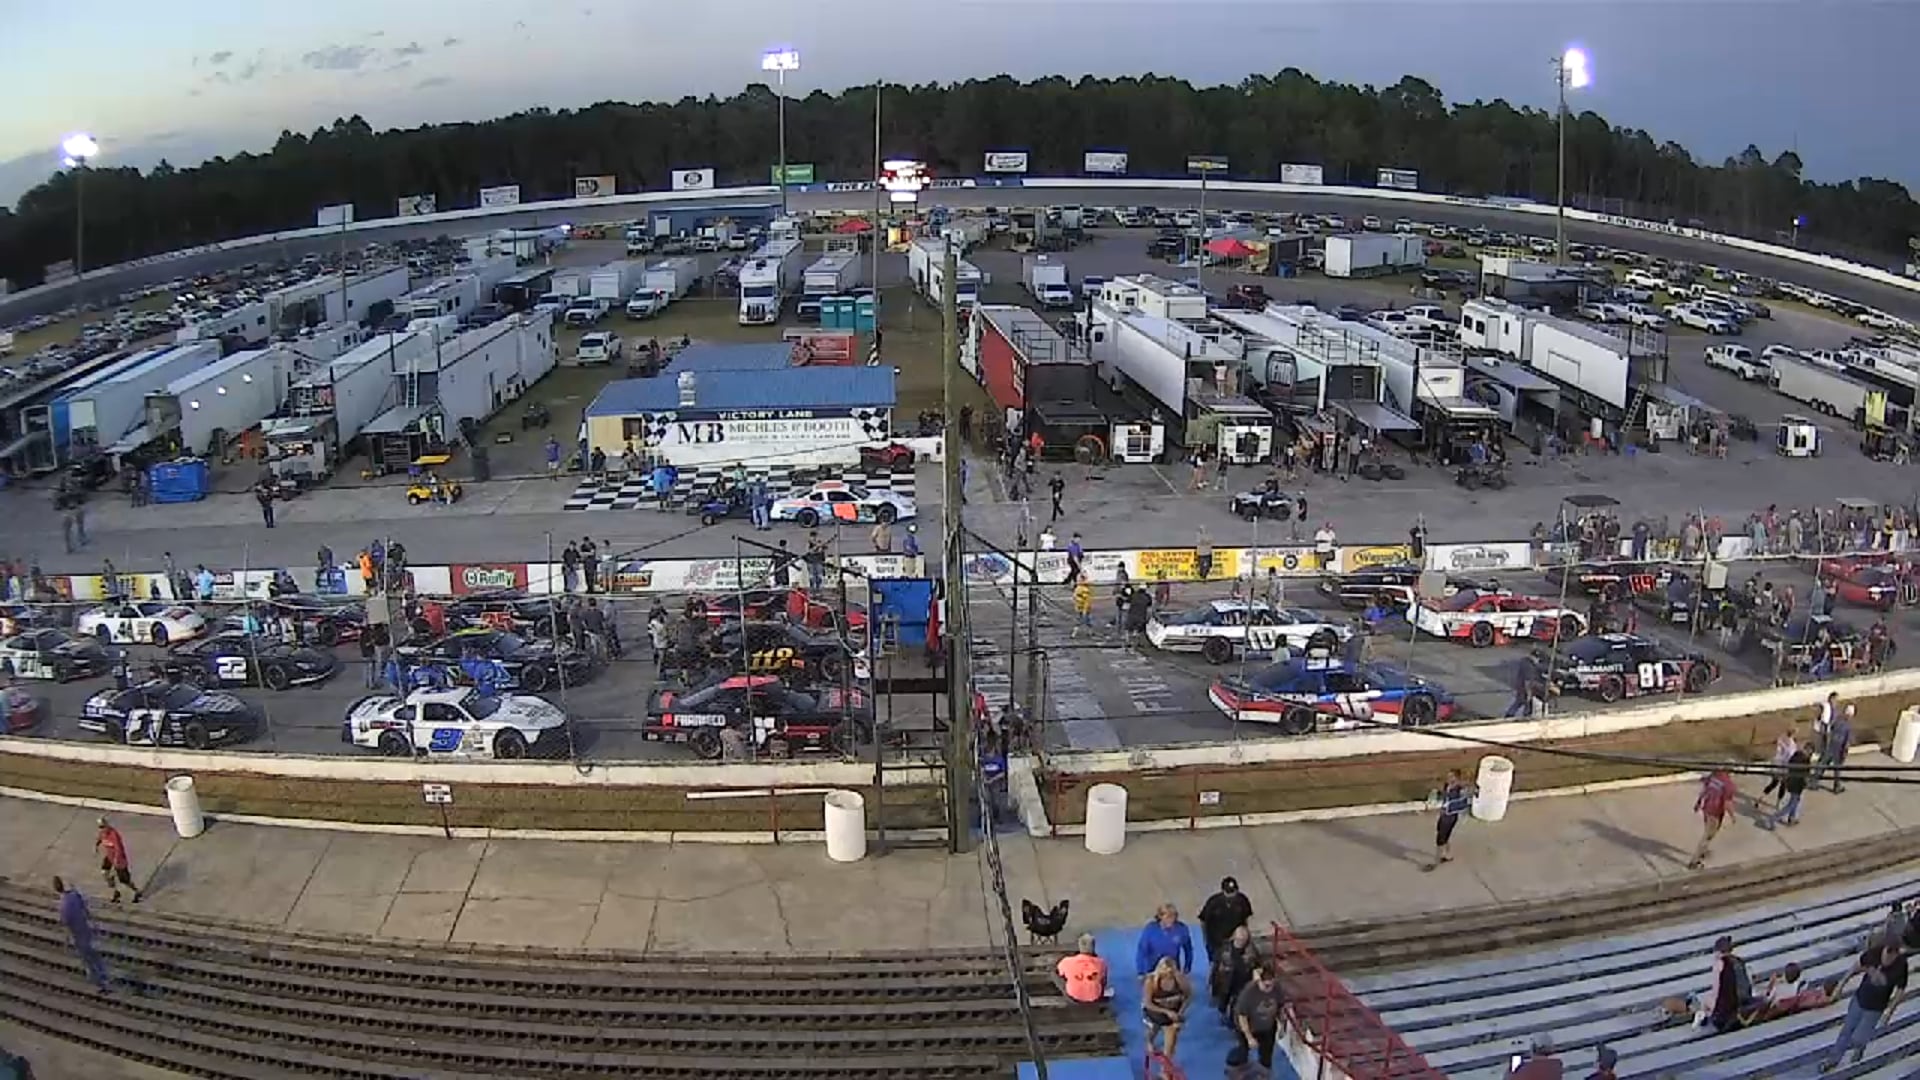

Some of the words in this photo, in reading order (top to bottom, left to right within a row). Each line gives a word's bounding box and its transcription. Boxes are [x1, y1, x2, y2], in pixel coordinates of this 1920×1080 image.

[718, 411, 774, 420] VICTORY
[779, 410, 814, 419] LANE
[728, 422, 787, 433] MICHLES
[803, 420, 851, 432] BOOTH
